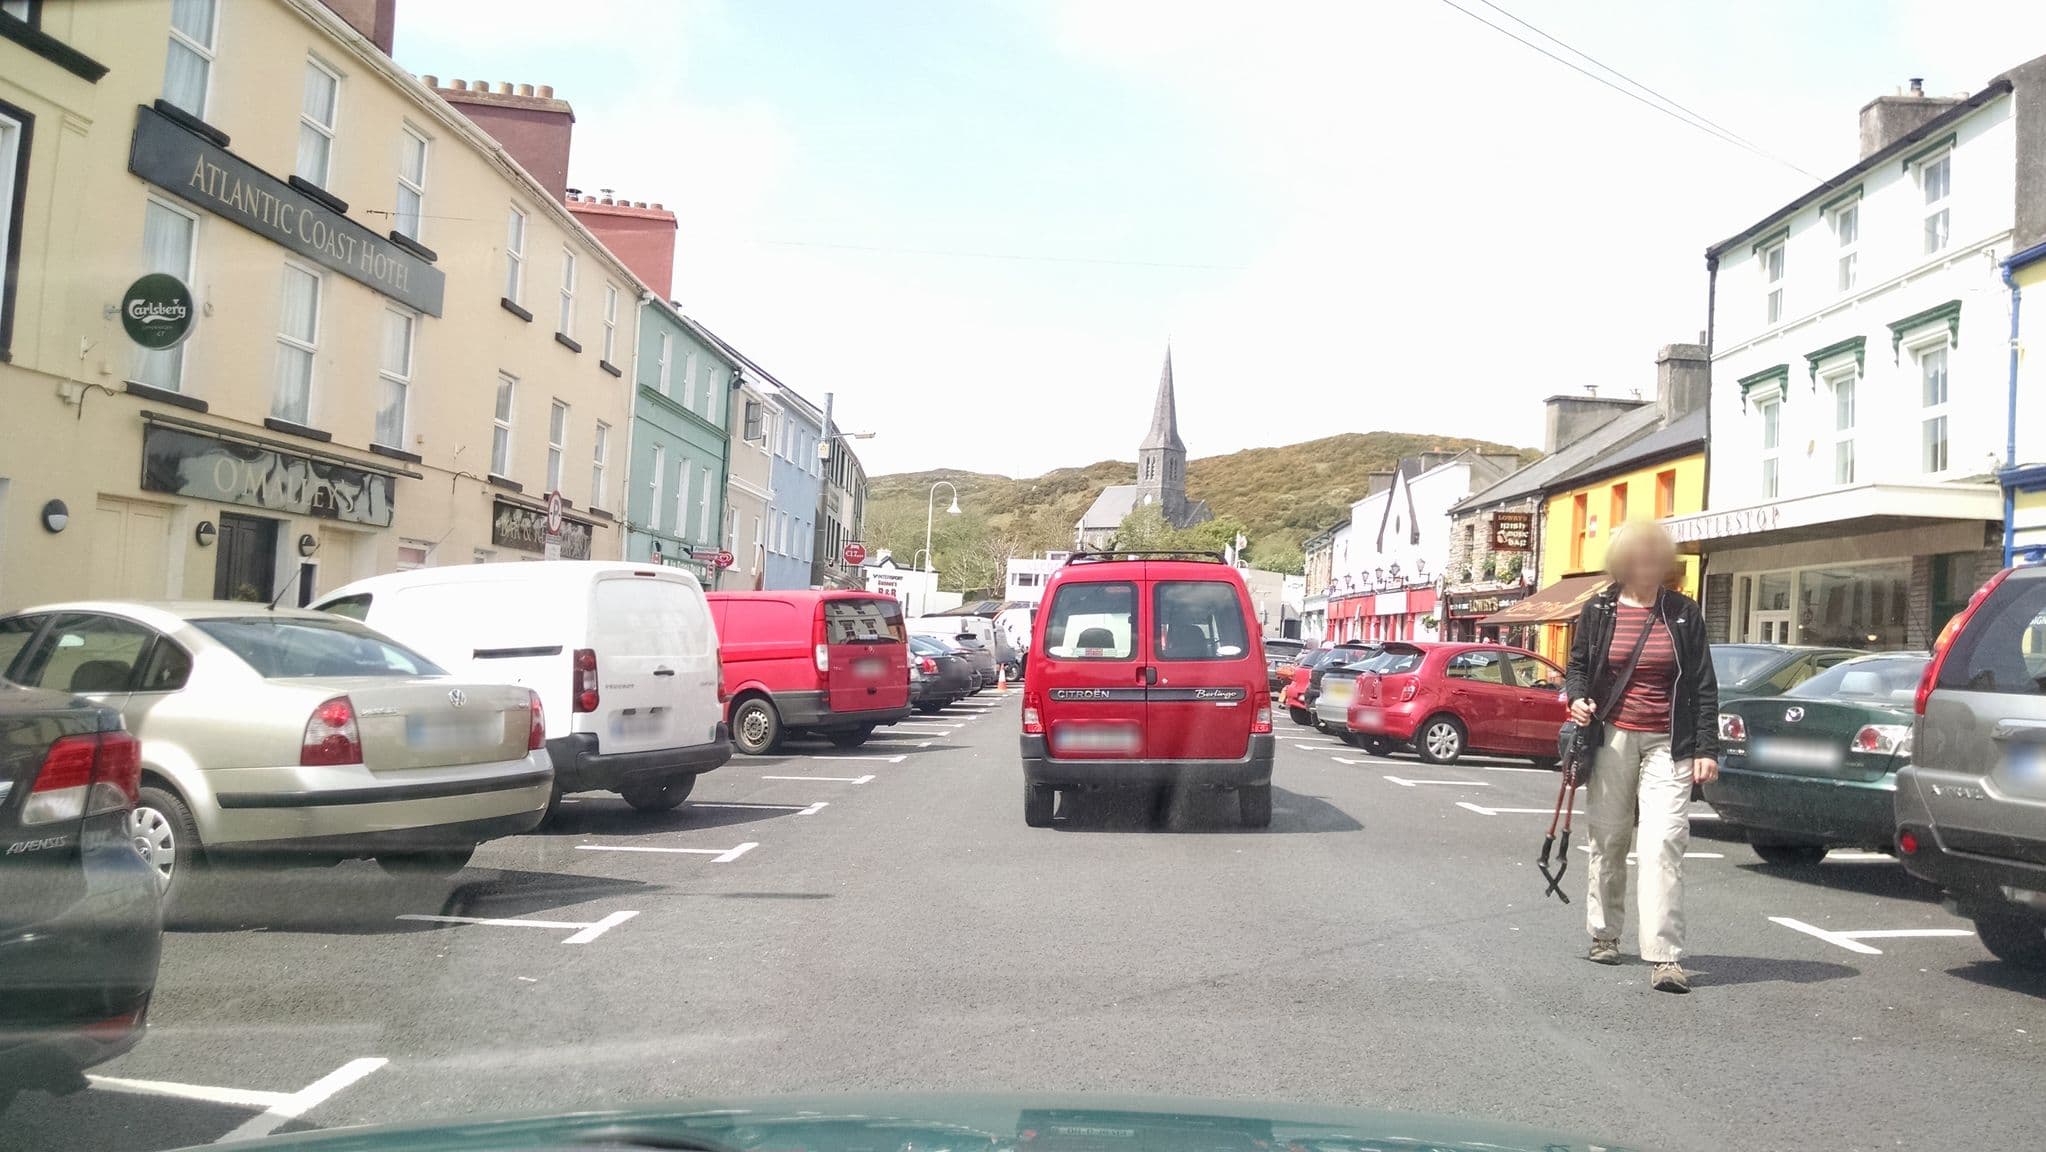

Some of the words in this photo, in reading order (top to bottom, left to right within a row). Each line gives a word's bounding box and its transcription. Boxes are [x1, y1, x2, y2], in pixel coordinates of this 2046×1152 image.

[189, 154, 294, 235] ATLANTIC
[299, 209, 357, 265] COAST
[360, 241, 409, 294] HOTEL
[128, 298, 187, 320] Carlsberg
[213, 457, 354, 513] O'MALLEY'S
[1057, 688, 1110, 698] CITROËN
[1195, 688, 1237, 699] Berlingo
[6, 835, 68, 855] AVENSIS
